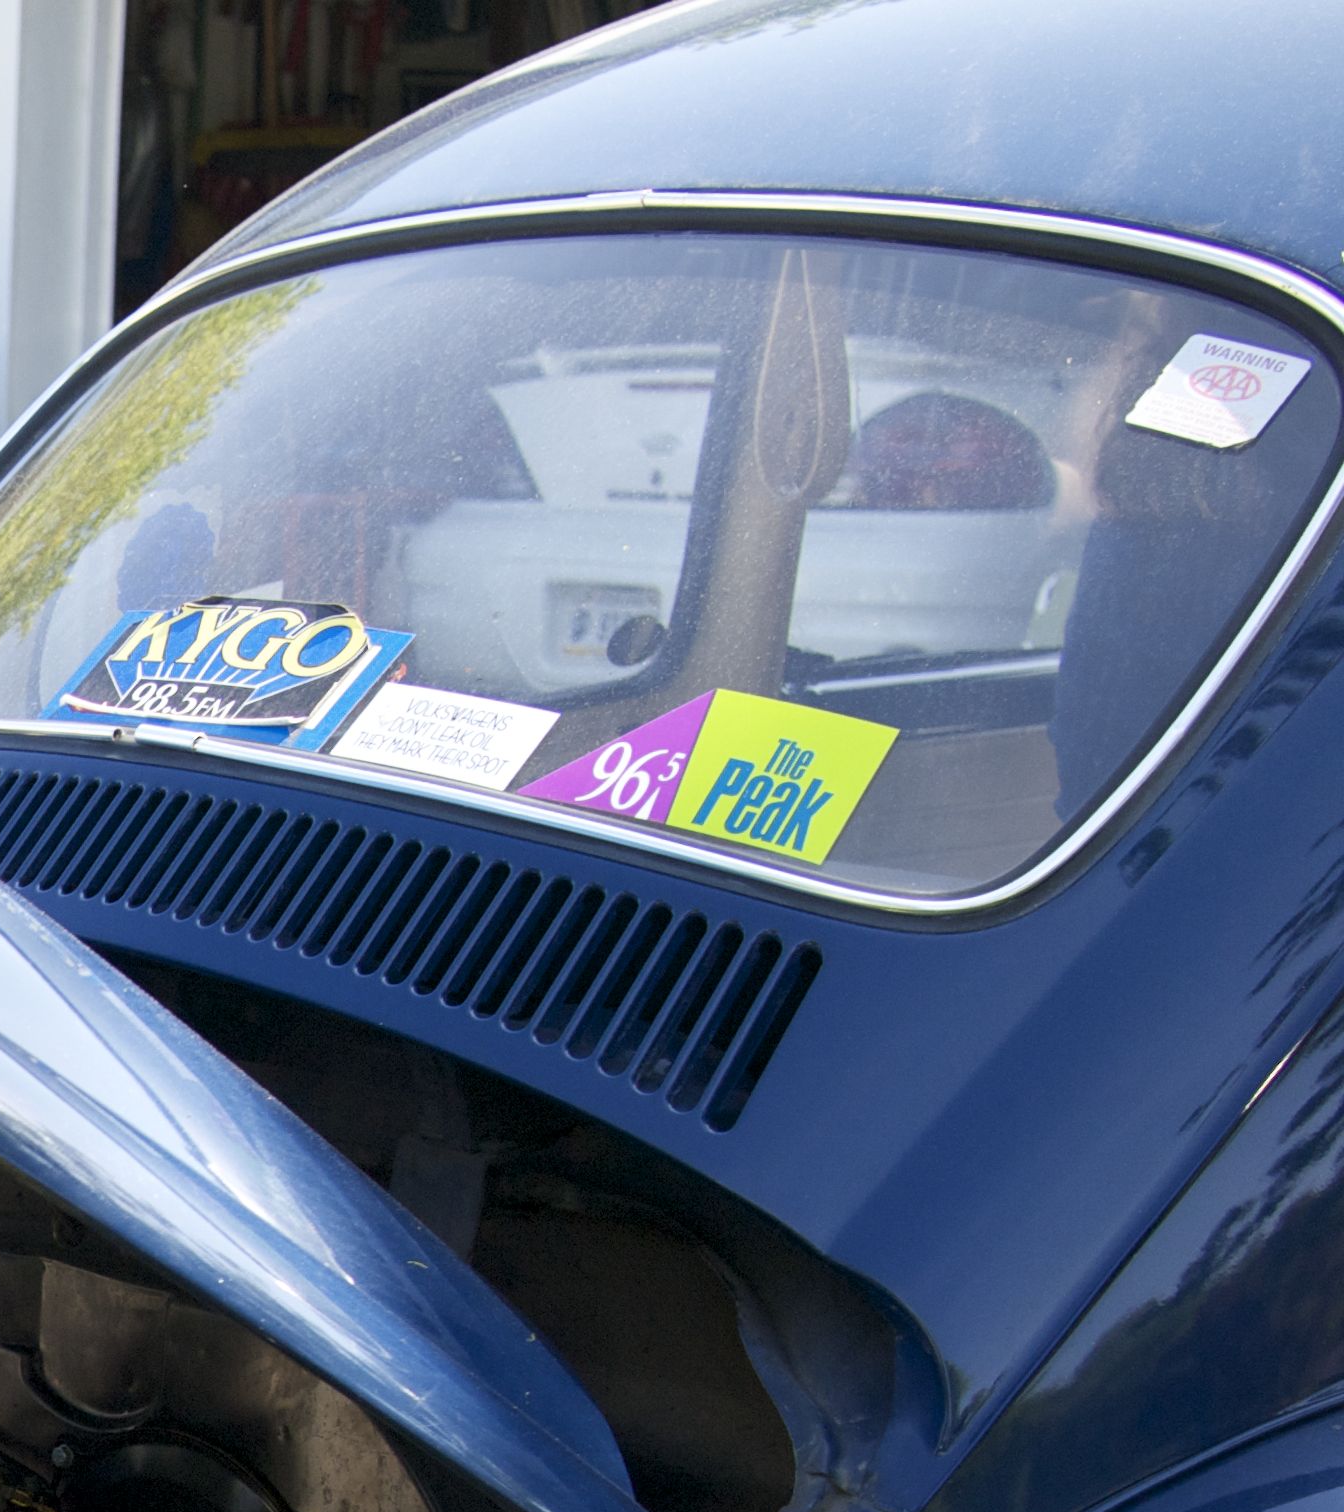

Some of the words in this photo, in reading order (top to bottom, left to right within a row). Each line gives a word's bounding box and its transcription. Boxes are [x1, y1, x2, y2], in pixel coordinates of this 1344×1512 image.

[1203, 343, 1287, 373] WARNING
[1191, 366, 1260, 401] AAA
[110, 605, 365, 677] KYGO
[388, 716, 435, 740] DON'T
[430, 723, 472, 744] LEAK
[470, 733, 494, 751] OIL
[406, 698, 513, 732] VOLKSWAGENS
[355, 731, 394, 750] THEY
[387, 736, 429, 758] MARK
[426, 744, 470, 766] THEIR
[466, 753, 510, 776] SPOT
[764, 738, 815, 780] The
[691, 758, 834, 852] Peak
